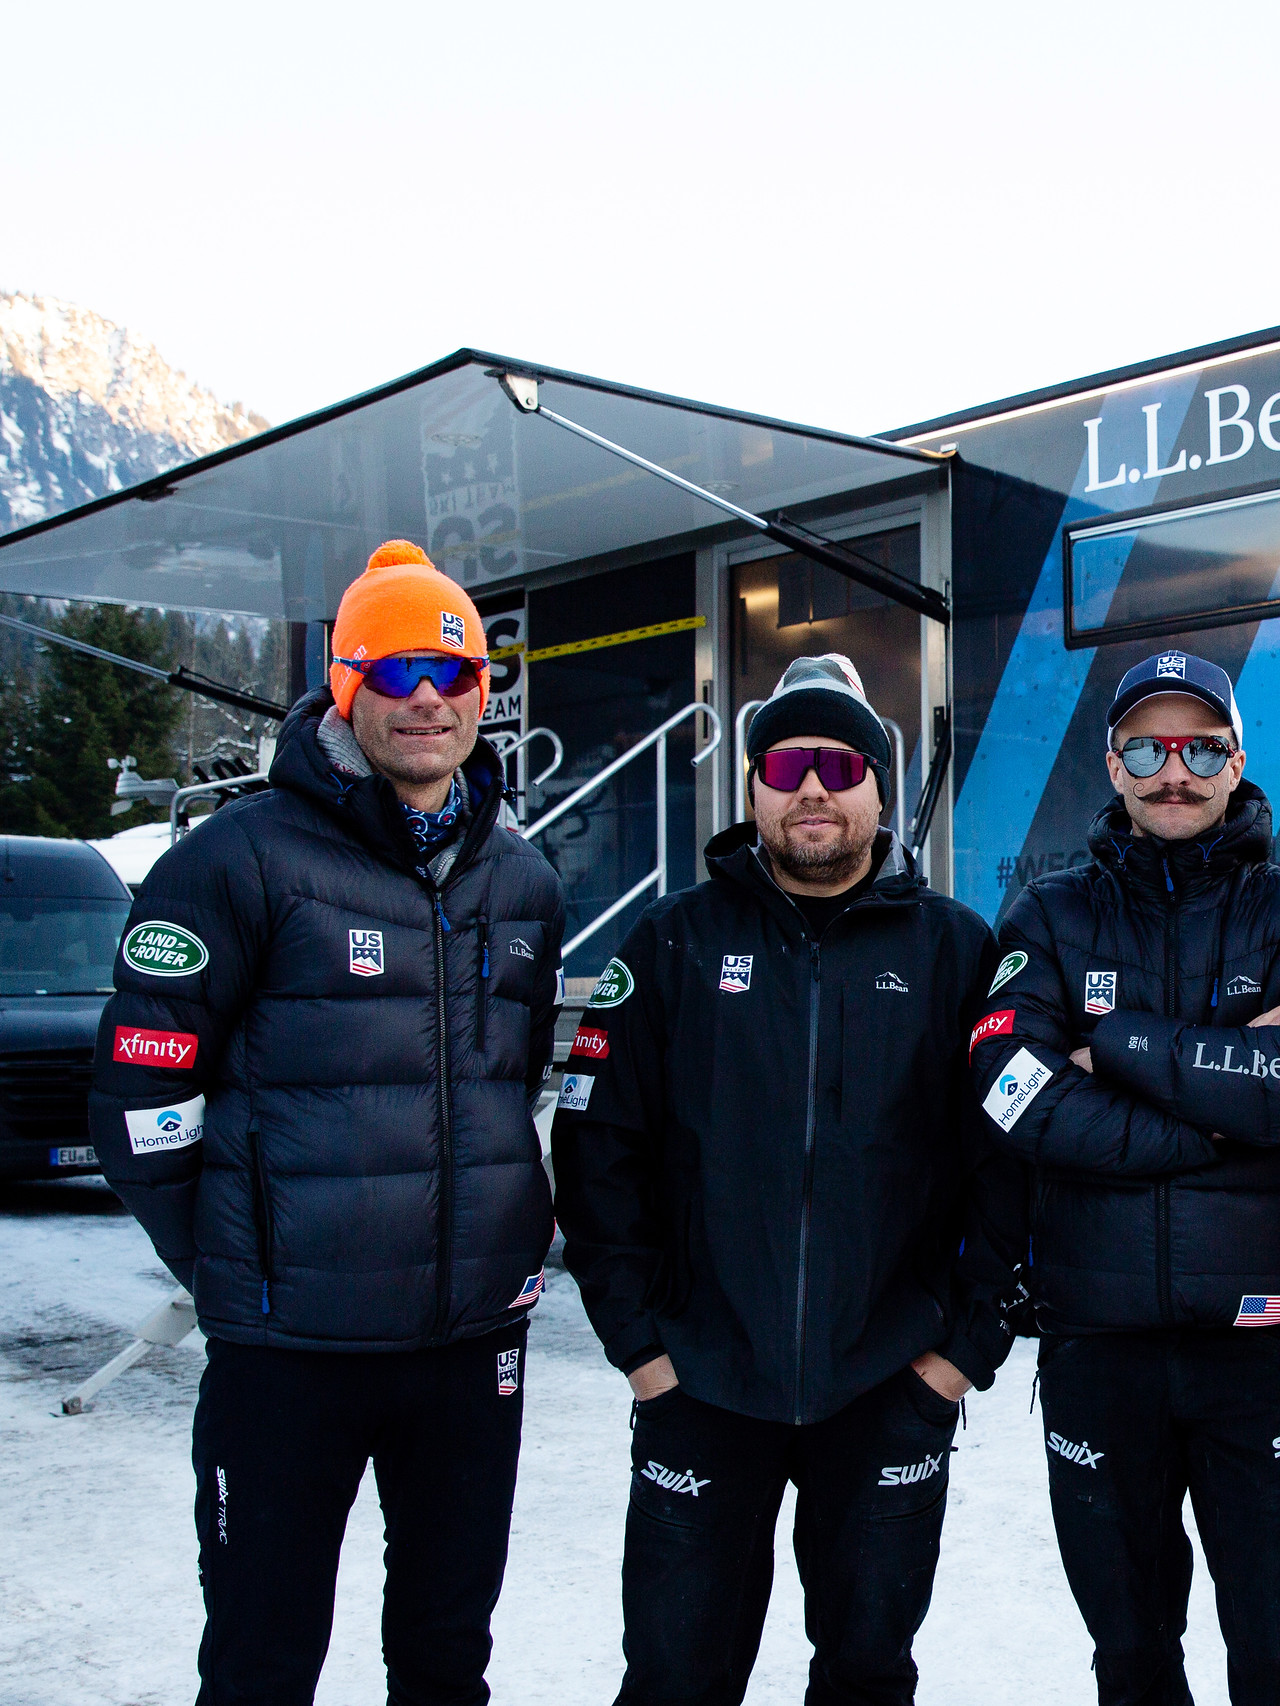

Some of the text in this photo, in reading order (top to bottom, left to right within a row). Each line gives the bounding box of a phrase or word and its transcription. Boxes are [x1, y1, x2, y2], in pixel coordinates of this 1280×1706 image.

[443, 612, 464, 628] US
[1160, 656, 1184, 665] US
[482, 694, 521, 721] EAM
[137, 930, 177, 949] LAND
[351, 932, 380, 947] US
[135, 947, 188, 967] ROVER
[724, 956, 751, 968] US
[875, 981, 909, 993] L.L.Bean
[1088, 973, 1114, 988] US
[1227, 984, 1262, 996] L.L.Bean
[118, 1033, 192, 1063] xfinity
[998, 1066, 1046, 1127] HomeLight
[134, 1125, 204, 1149] HomeLigh
[499, 1350, 518, 1367] US
